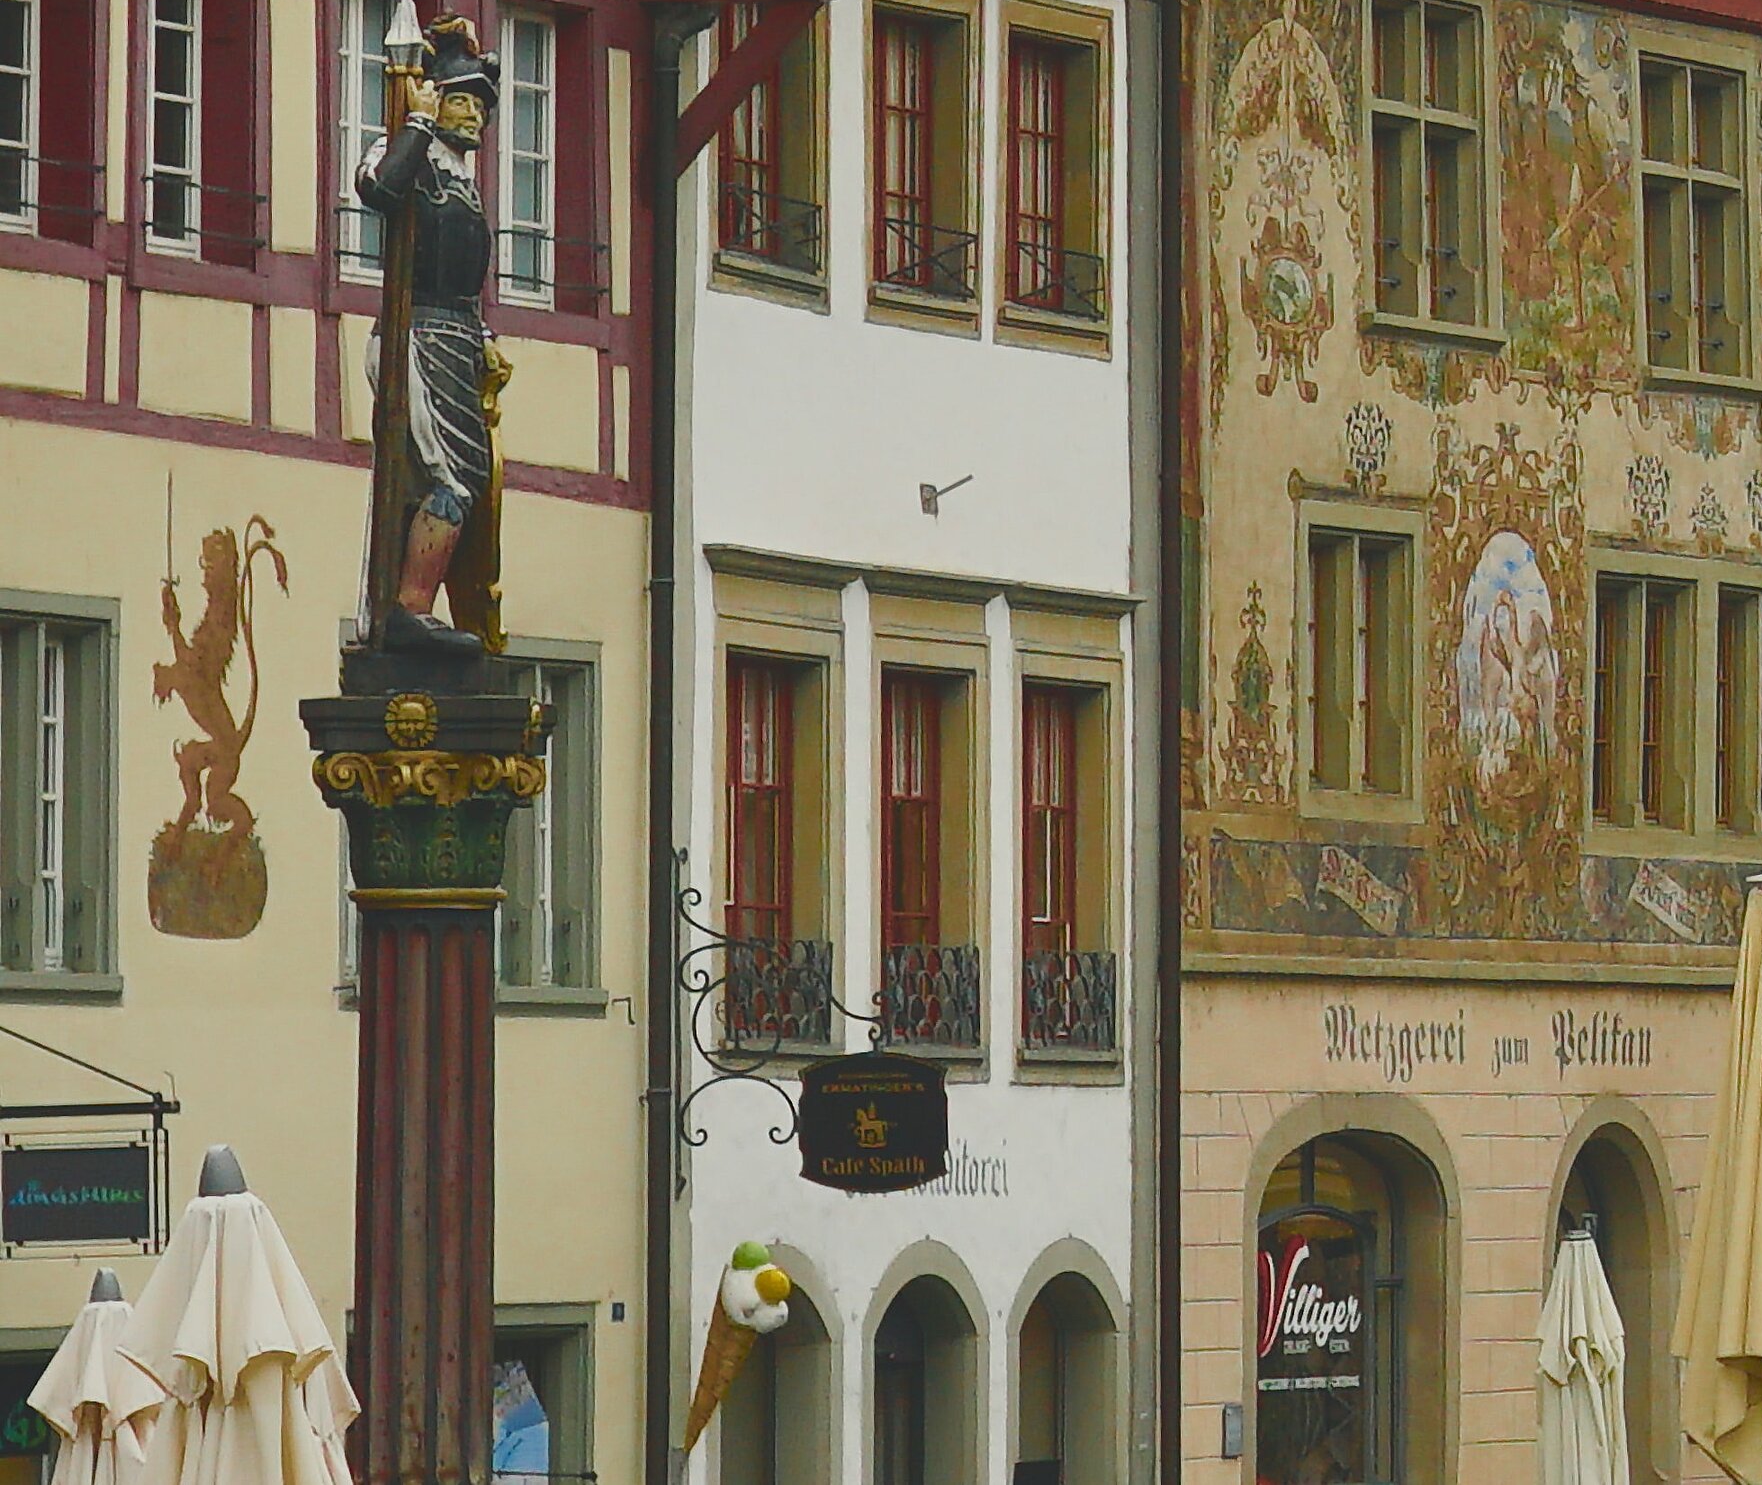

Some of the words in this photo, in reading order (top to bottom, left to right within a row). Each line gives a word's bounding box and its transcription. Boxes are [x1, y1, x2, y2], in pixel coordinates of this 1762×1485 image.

[1324, 1005, 1465, 1083] Metzgerei
[1491, 1036, 1529, 1078] zum
[1551, 1008, 1651, 1082] Pelikan
[1257, 1233, 1362, 1358] Villiger
